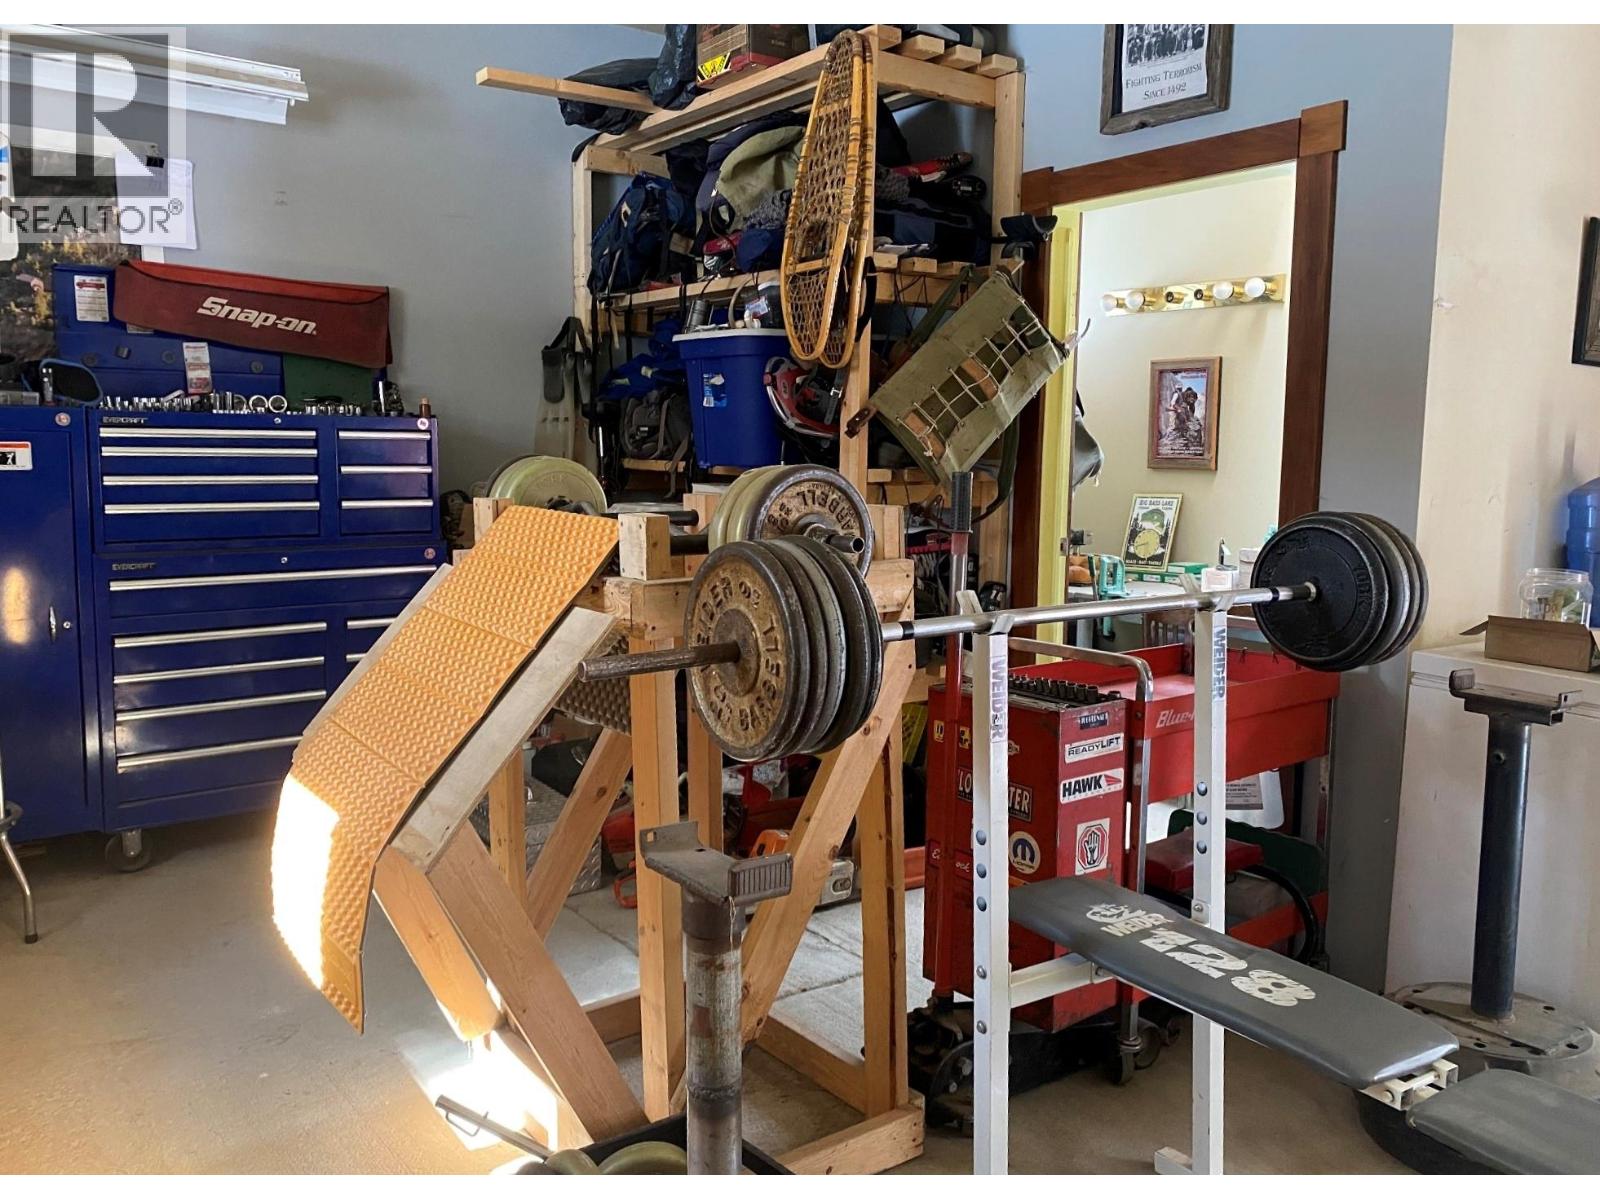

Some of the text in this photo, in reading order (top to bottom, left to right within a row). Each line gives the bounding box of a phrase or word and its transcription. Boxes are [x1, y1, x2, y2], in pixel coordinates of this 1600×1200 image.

[1163, 62, 1202, 81] TERRORISM
[1143, 82, 1188, 100] SINCE 1492
[196, 296, 318, 336] Snap-on
[1213, 627, 1226, 699] WEIDER
[990, 659, 1006, 739] WEIDER
[1068, 736, 1121, 757] READYLIFT
[1062, 774, 1103, 798] HAWK
[1101, 912, 1176, 937] WEIDER
